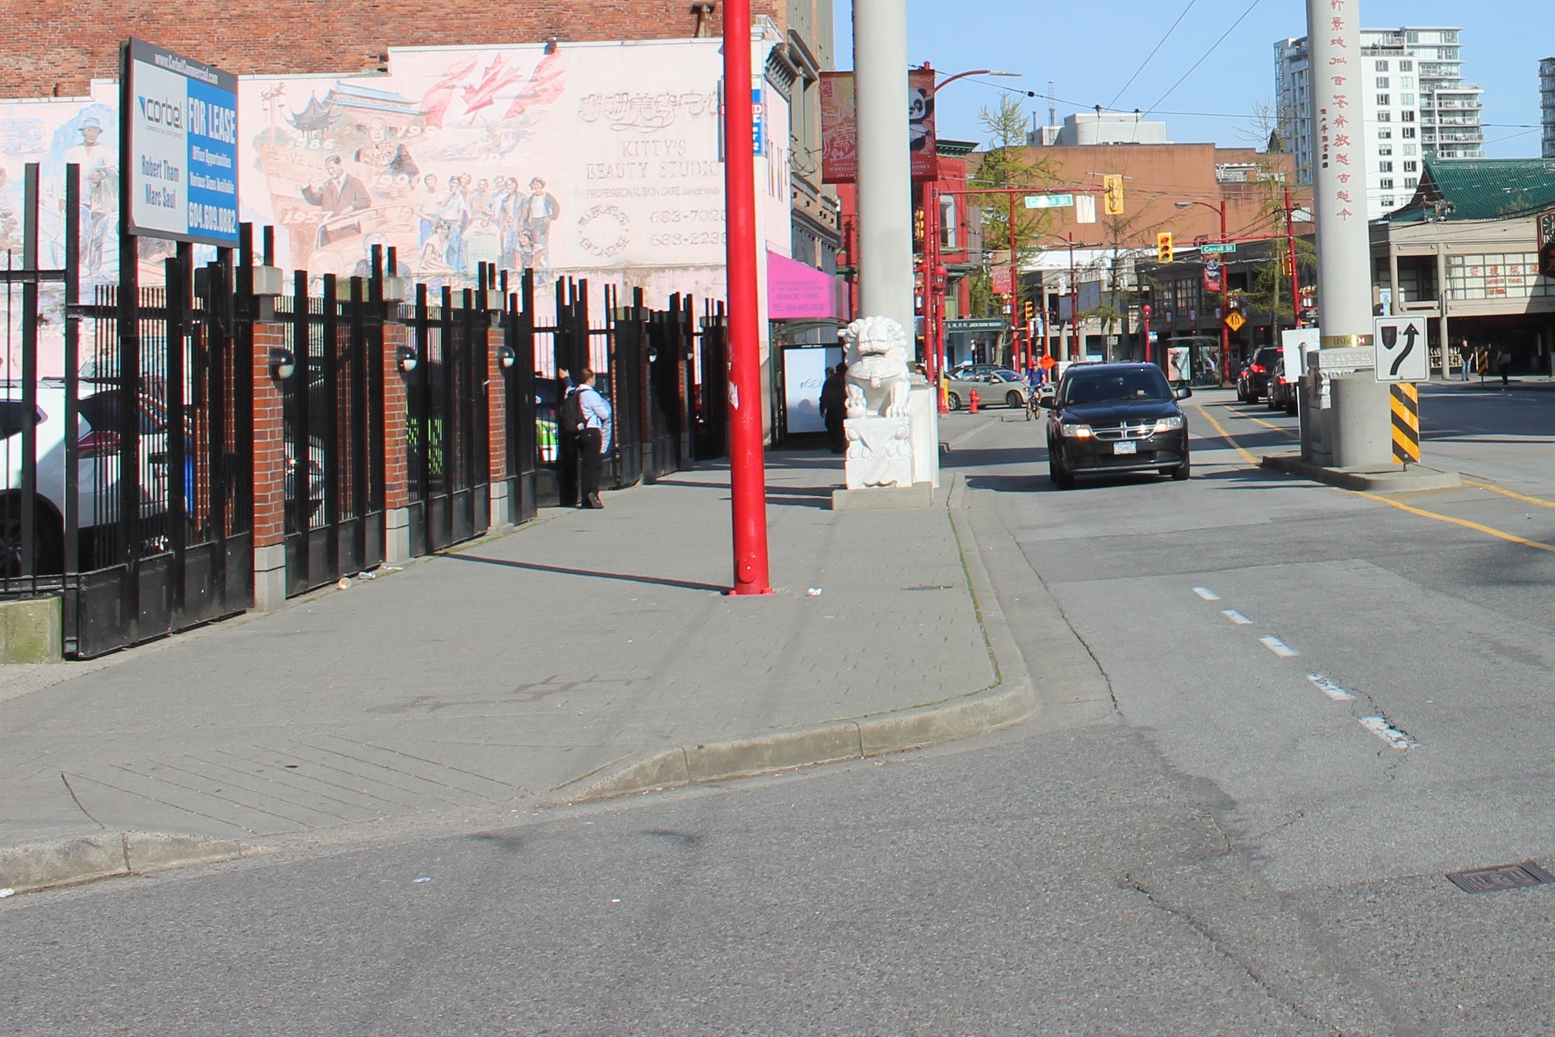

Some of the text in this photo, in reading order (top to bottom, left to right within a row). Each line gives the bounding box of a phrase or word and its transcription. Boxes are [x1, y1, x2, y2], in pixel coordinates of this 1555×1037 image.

[146, 96, 184, 130] corbel
[188, 96, 236, 145] FOR LEASE
[621, 139, 687, 157] KITTY'S
[141, 153, 180, 182] Robert Tham
[586, 162, 649, 180] BEAUTY
[145, 182, 177, 210] Marc Saul
[585, 187, 641, 199] PROFESSIONAL
[1058, 196, 1069, 205] St
